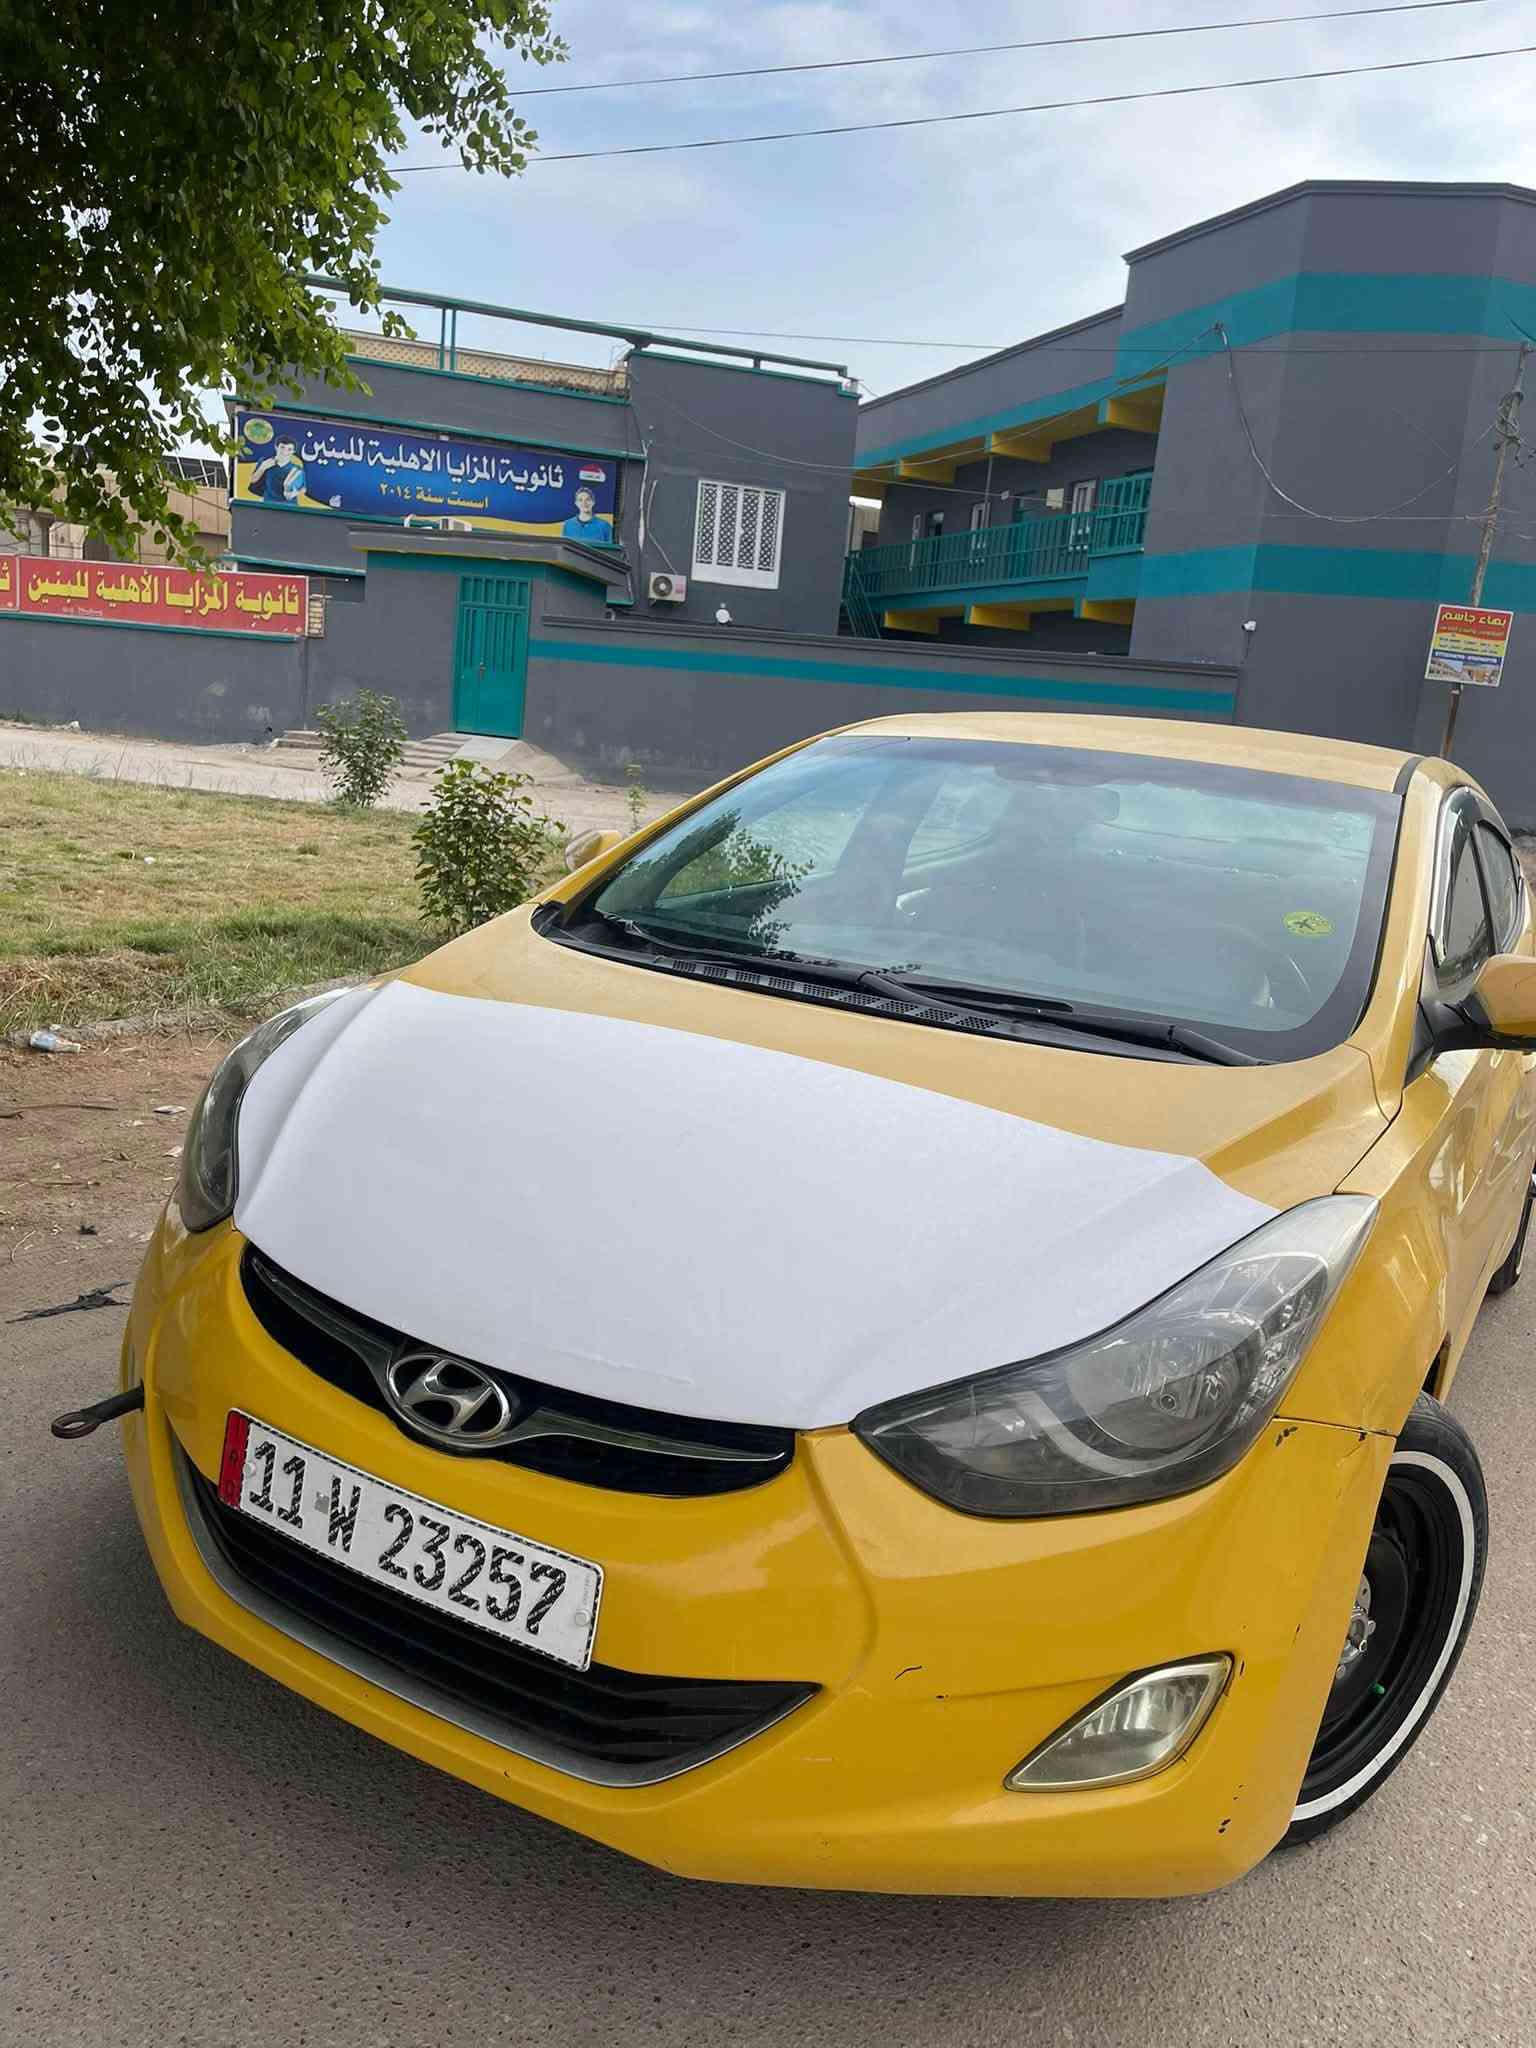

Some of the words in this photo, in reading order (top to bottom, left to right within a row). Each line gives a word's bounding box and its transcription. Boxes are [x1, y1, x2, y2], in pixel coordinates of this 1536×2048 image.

[300, 431, 365, 467] للبنين
[367, 439, 441, 474] الاهلية
[445, 450, 496, 484] المزايا
[497, 457, 564, 492] ثانوية
[379, 482, 412, 499] ٢٠١٤
[415, 486, 445, 504] سنة
[27, 569, 89, 604] للبنين
[165, 575, 228, 615] المزايا
[235, 581, 299, 620] ثانوية
[249, 1440, 307, 1530] 11
[327, 1474, 362, 1553] W
[377, 1503, 567, 1636] 23257
